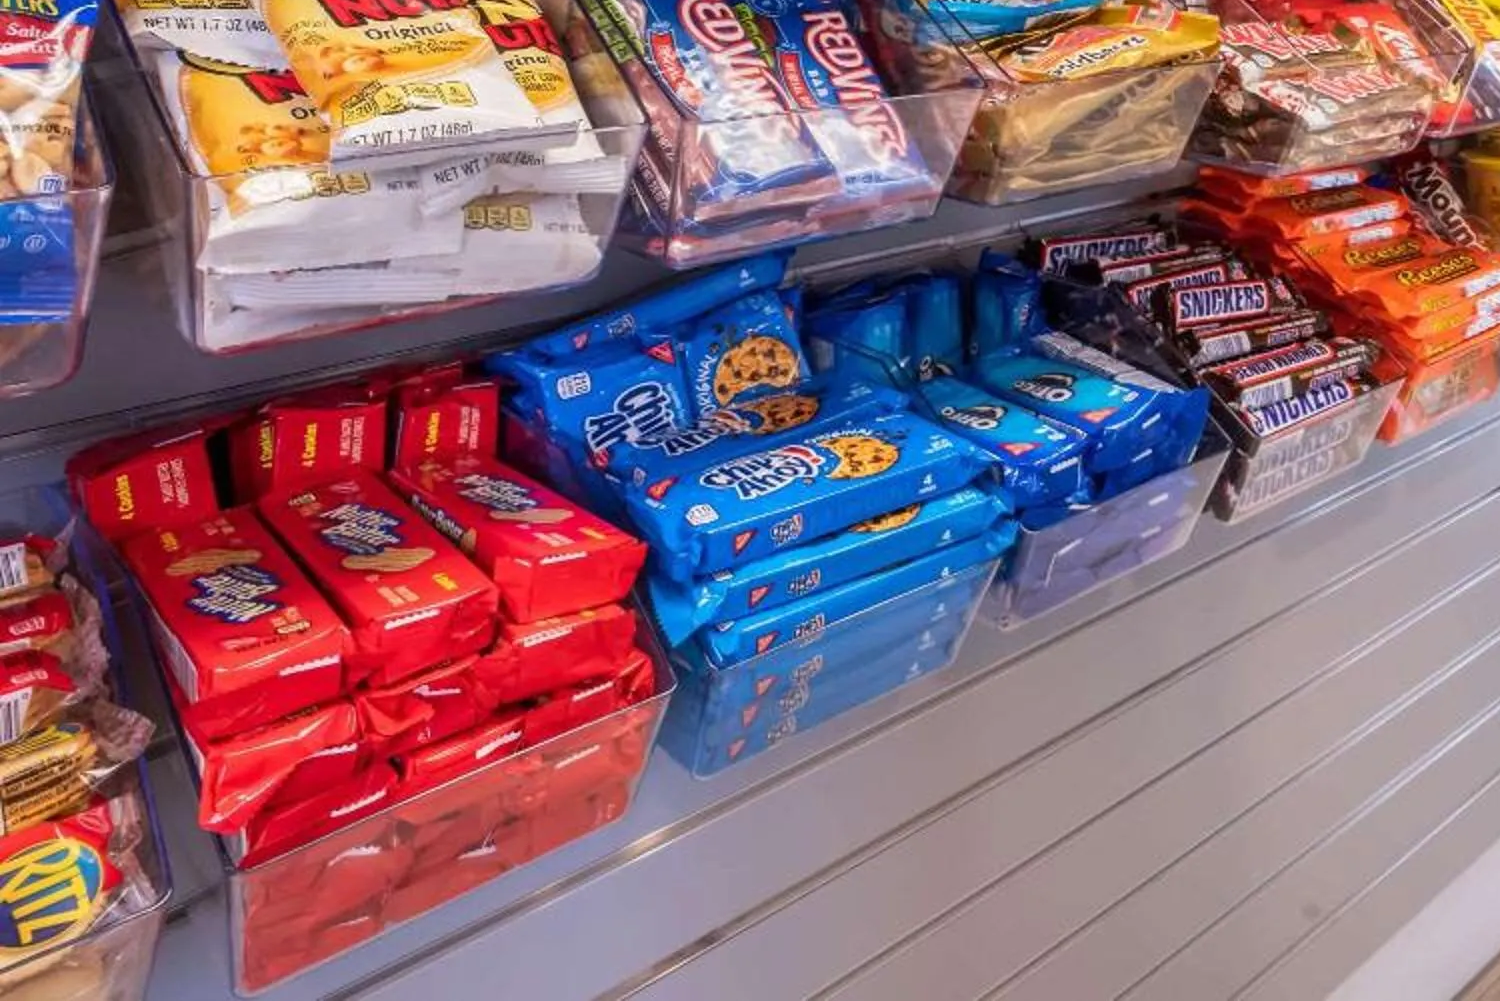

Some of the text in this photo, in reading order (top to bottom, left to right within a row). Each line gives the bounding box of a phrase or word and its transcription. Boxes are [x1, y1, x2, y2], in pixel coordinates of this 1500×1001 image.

[143, 17, 172, 32] NET
[176, 18, 197, 32] WT
[433, 166, 459, 186] NET
[1406, 161, 1480, 248] Moun
[1179, 284, 1266, 320] SNICKERS
[1253, 380, 1350, 435] SNICKERS
[0, 838, 91, 946] RITZ
